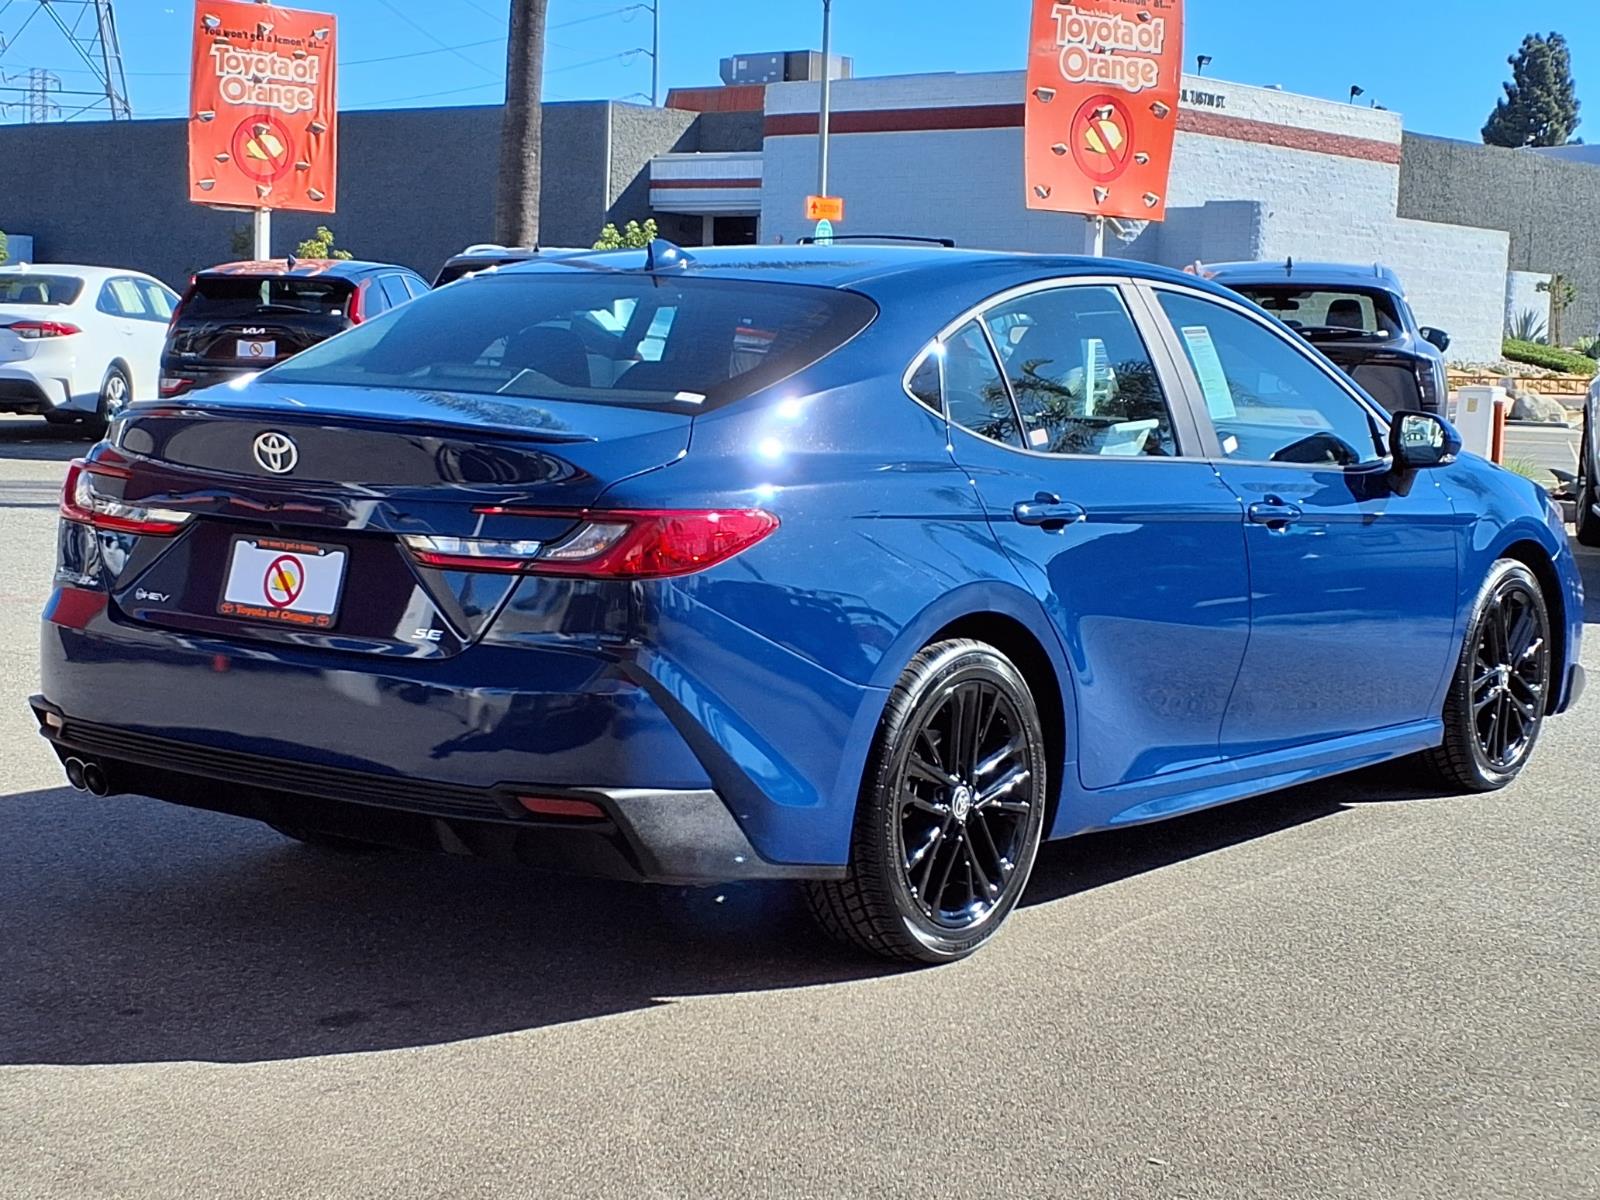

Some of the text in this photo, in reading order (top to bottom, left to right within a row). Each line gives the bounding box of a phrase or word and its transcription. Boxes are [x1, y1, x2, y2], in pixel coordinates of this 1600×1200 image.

[1051, 5, 1165, 54] Toyota of
[211, 44, 318, 84] Toyota of
[1060, 44, 1159, 92] Orange
[219, 75, 314, 113] Orange
[1190, 90, 1215, 107] TUSTIN
[411, 628, 444, 641] SE
